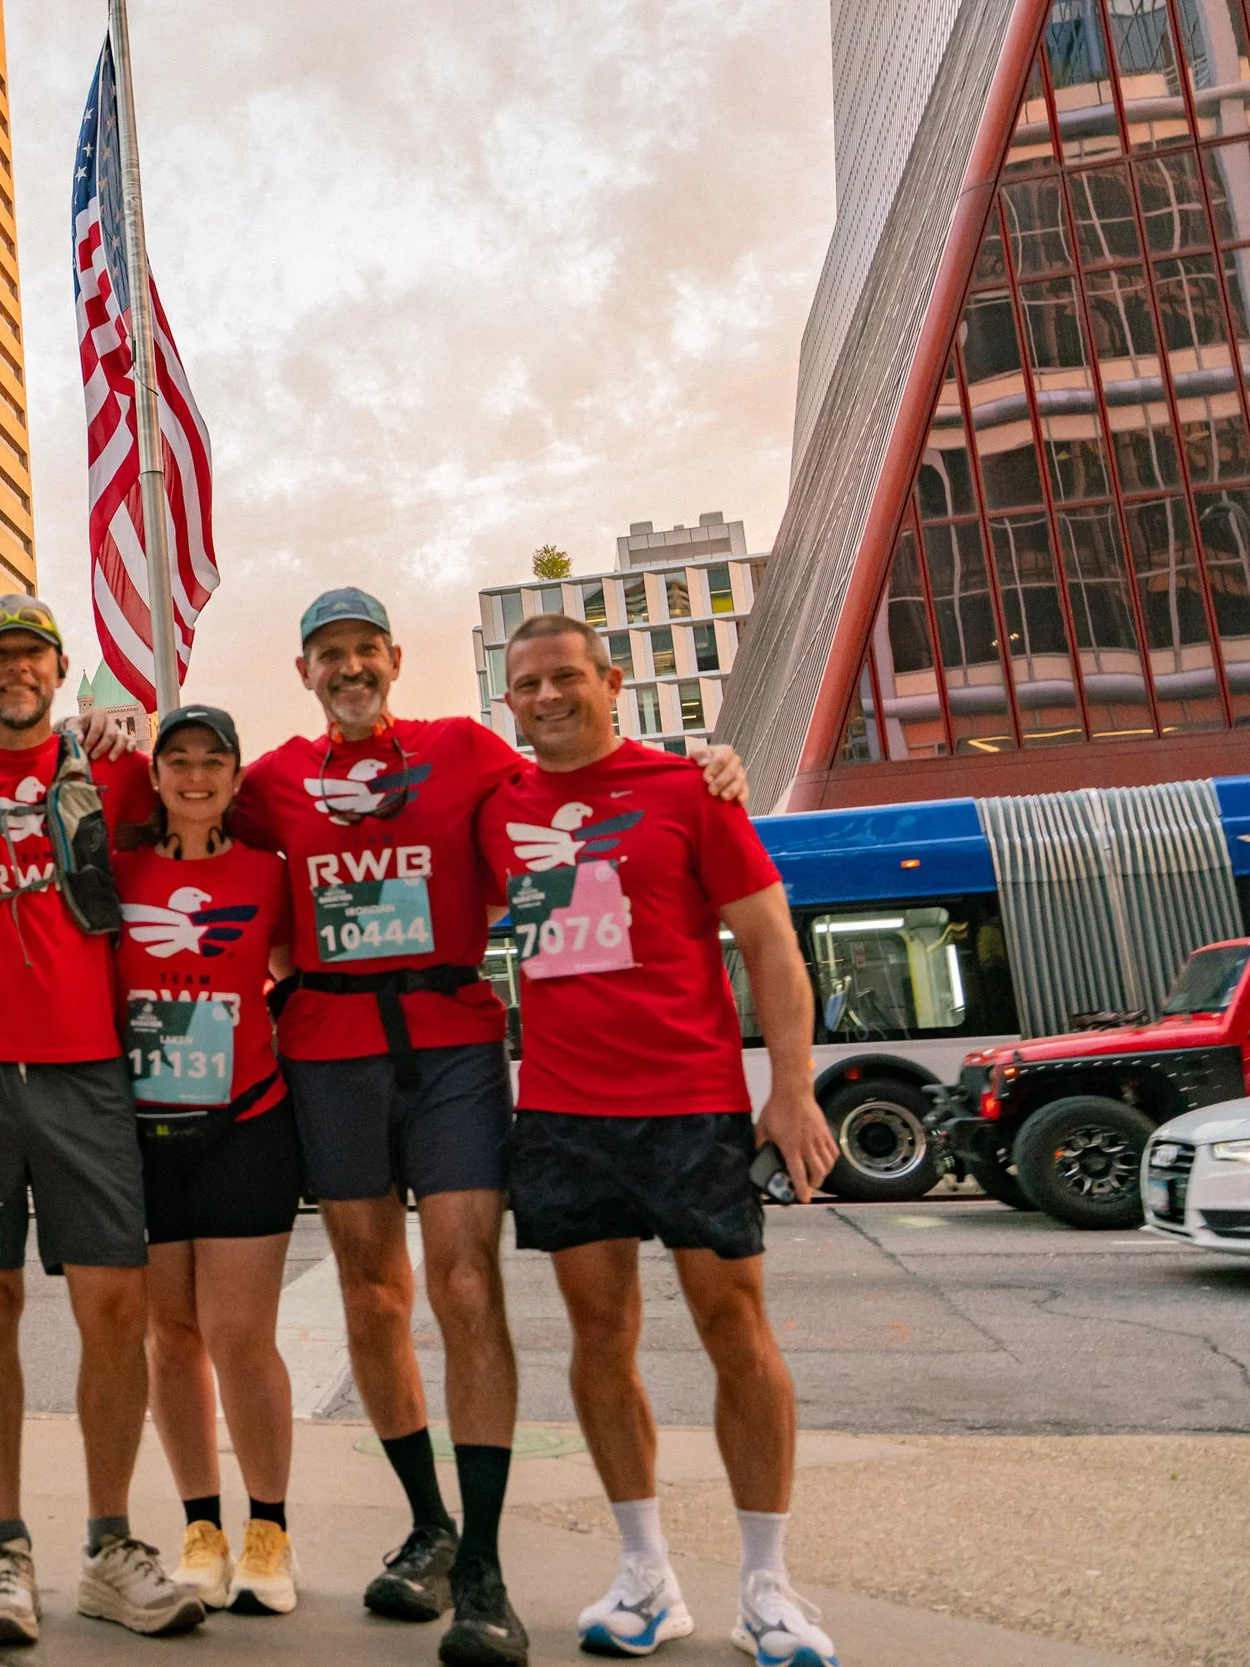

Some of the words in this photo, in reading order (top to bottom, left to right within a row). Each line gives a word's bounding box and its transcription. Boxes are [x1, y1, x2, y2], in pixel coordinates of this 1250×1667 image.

[307, 845, 432, 890] RWB
[320, 917, 430, 952] 10444
[515, 912, 623, 958] 7076
[128, 1048, 226, 1079] 11131
